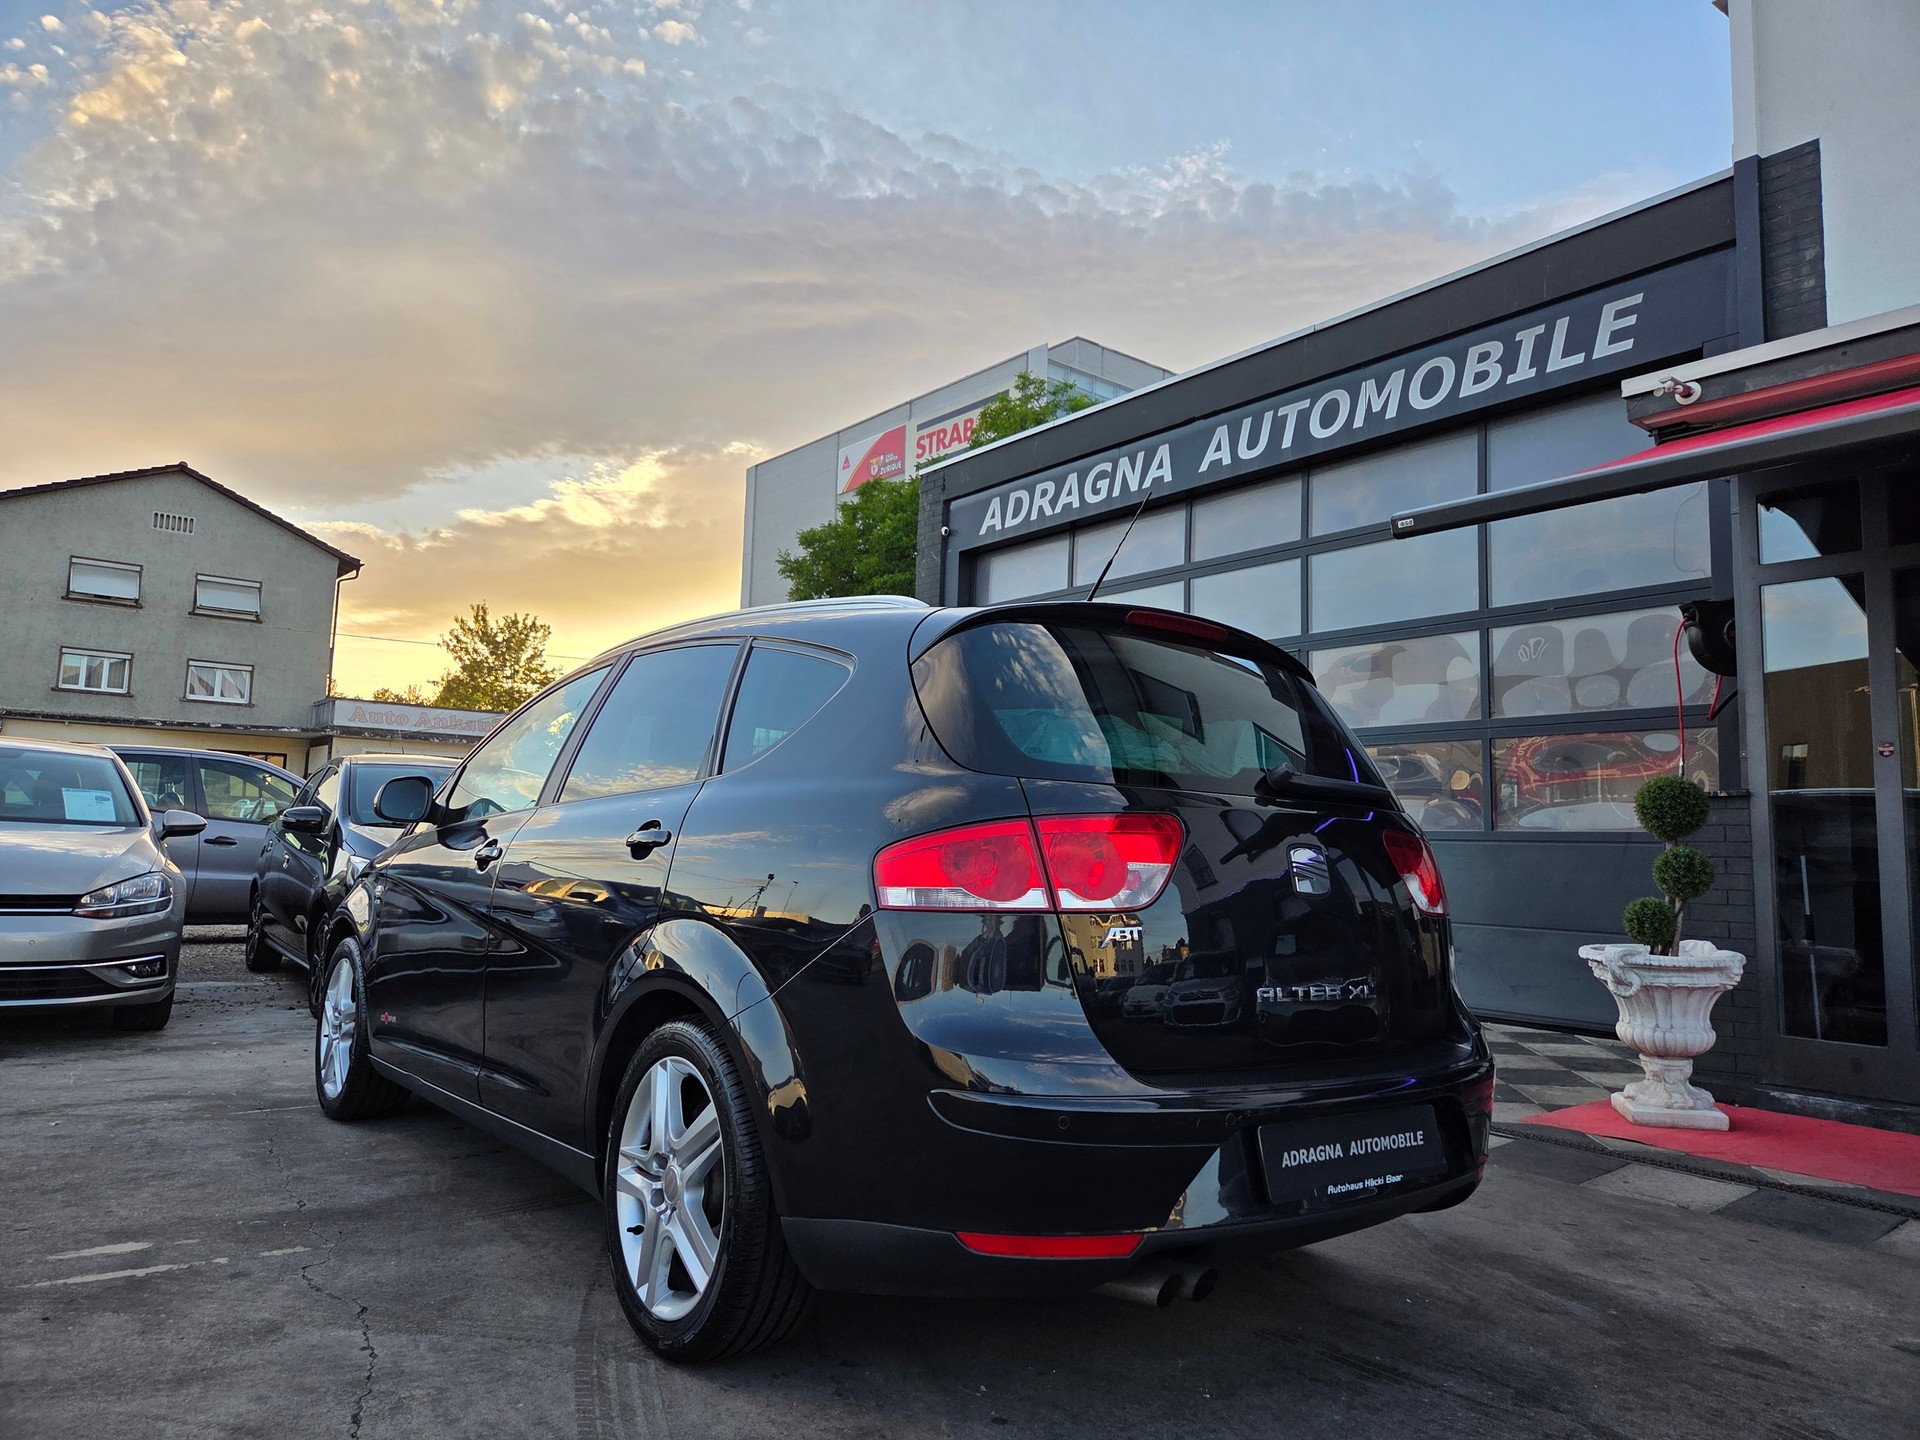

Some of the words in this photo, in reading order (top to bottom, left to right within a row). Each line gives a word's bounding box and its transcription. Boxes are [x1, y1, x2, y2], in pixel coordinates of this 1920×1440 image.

[980, 443, 1173, 536] ADRAGNA
[1199, 293, 1644, 473] AUTOMOBILE
[349, 706, 409, 726] Auto
[1101, 927, 1142, 948] ABT
[1349, 985, 1377, 1000] XL
[1282, 1143, 1343, 1168] ADRAGNA
[1350, 1131, 1424, 1156] AUTOMOBILE
[1327, 1181, 1363, 1195] Autohaus
[1386, 1174, 1403, 1184] Baar
